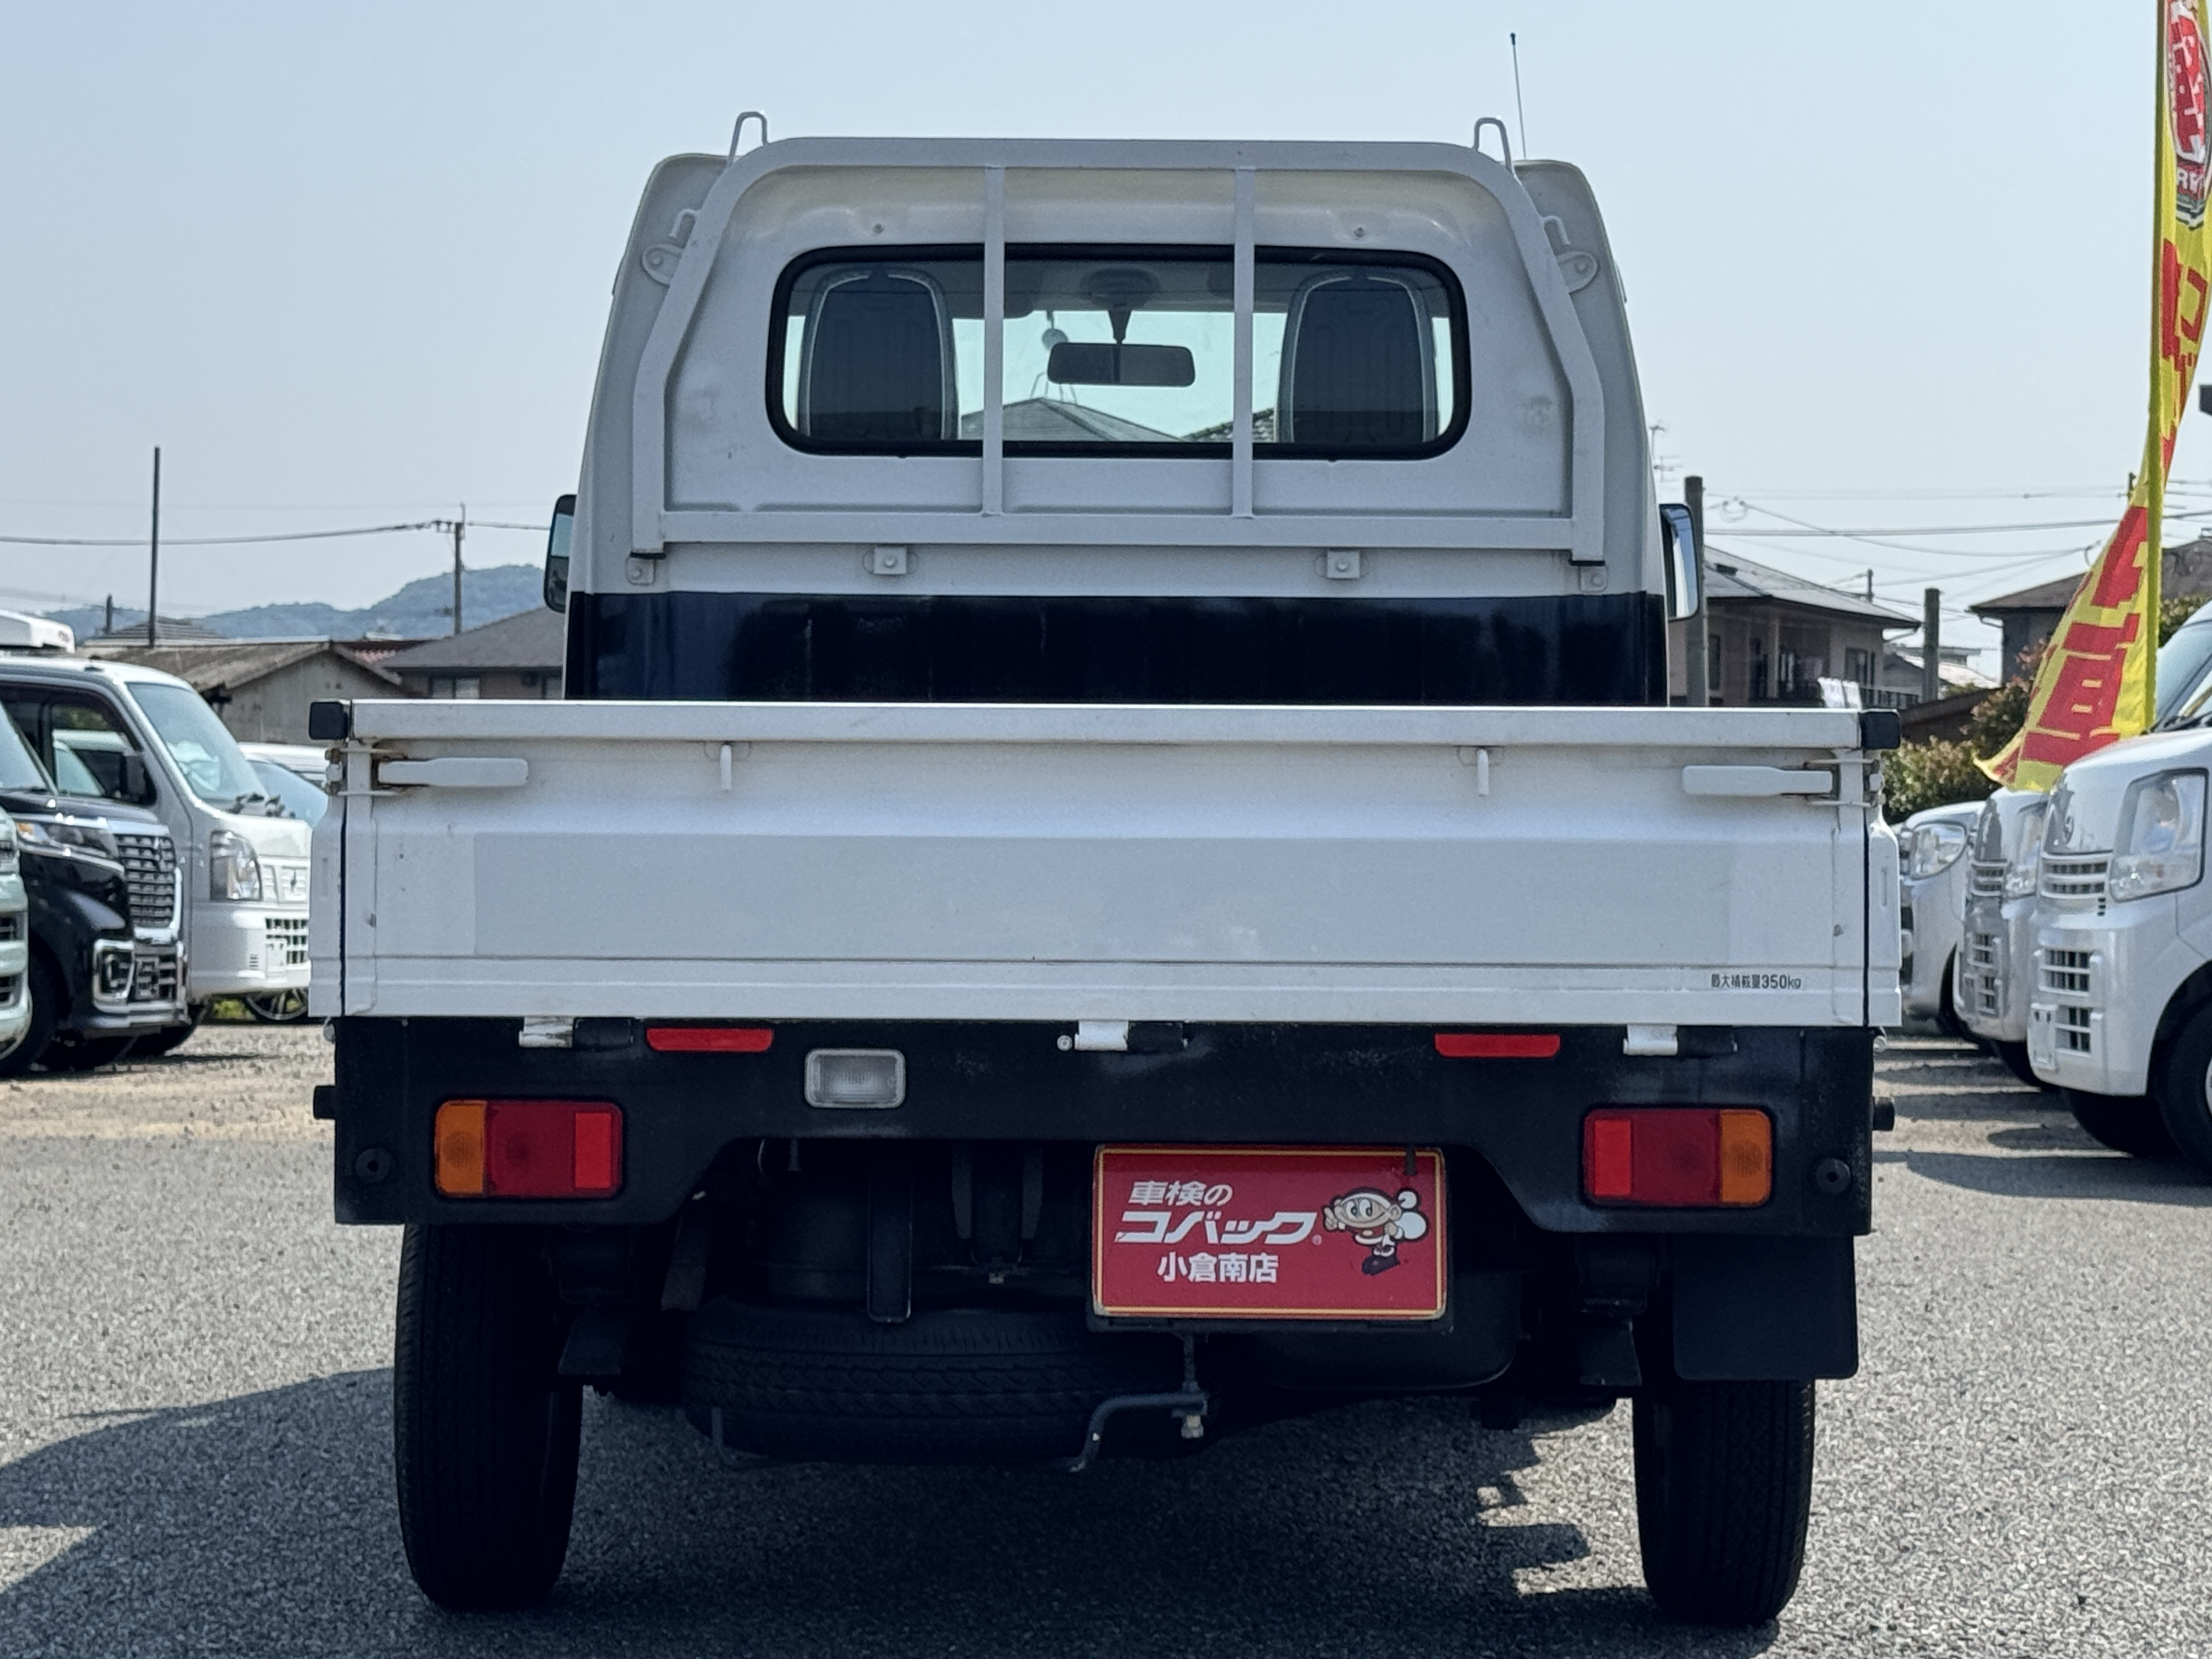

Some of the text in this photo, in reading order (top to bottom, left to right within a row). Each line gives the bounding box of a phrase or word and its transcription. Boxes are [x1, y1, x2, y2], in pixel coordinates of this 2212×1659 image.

[1128, 1181, 1233, 1206] 車検の
[1114, 1211, 1317, 1245] コバック
[1157, 1252, 1279, 1283] 小倉南店
